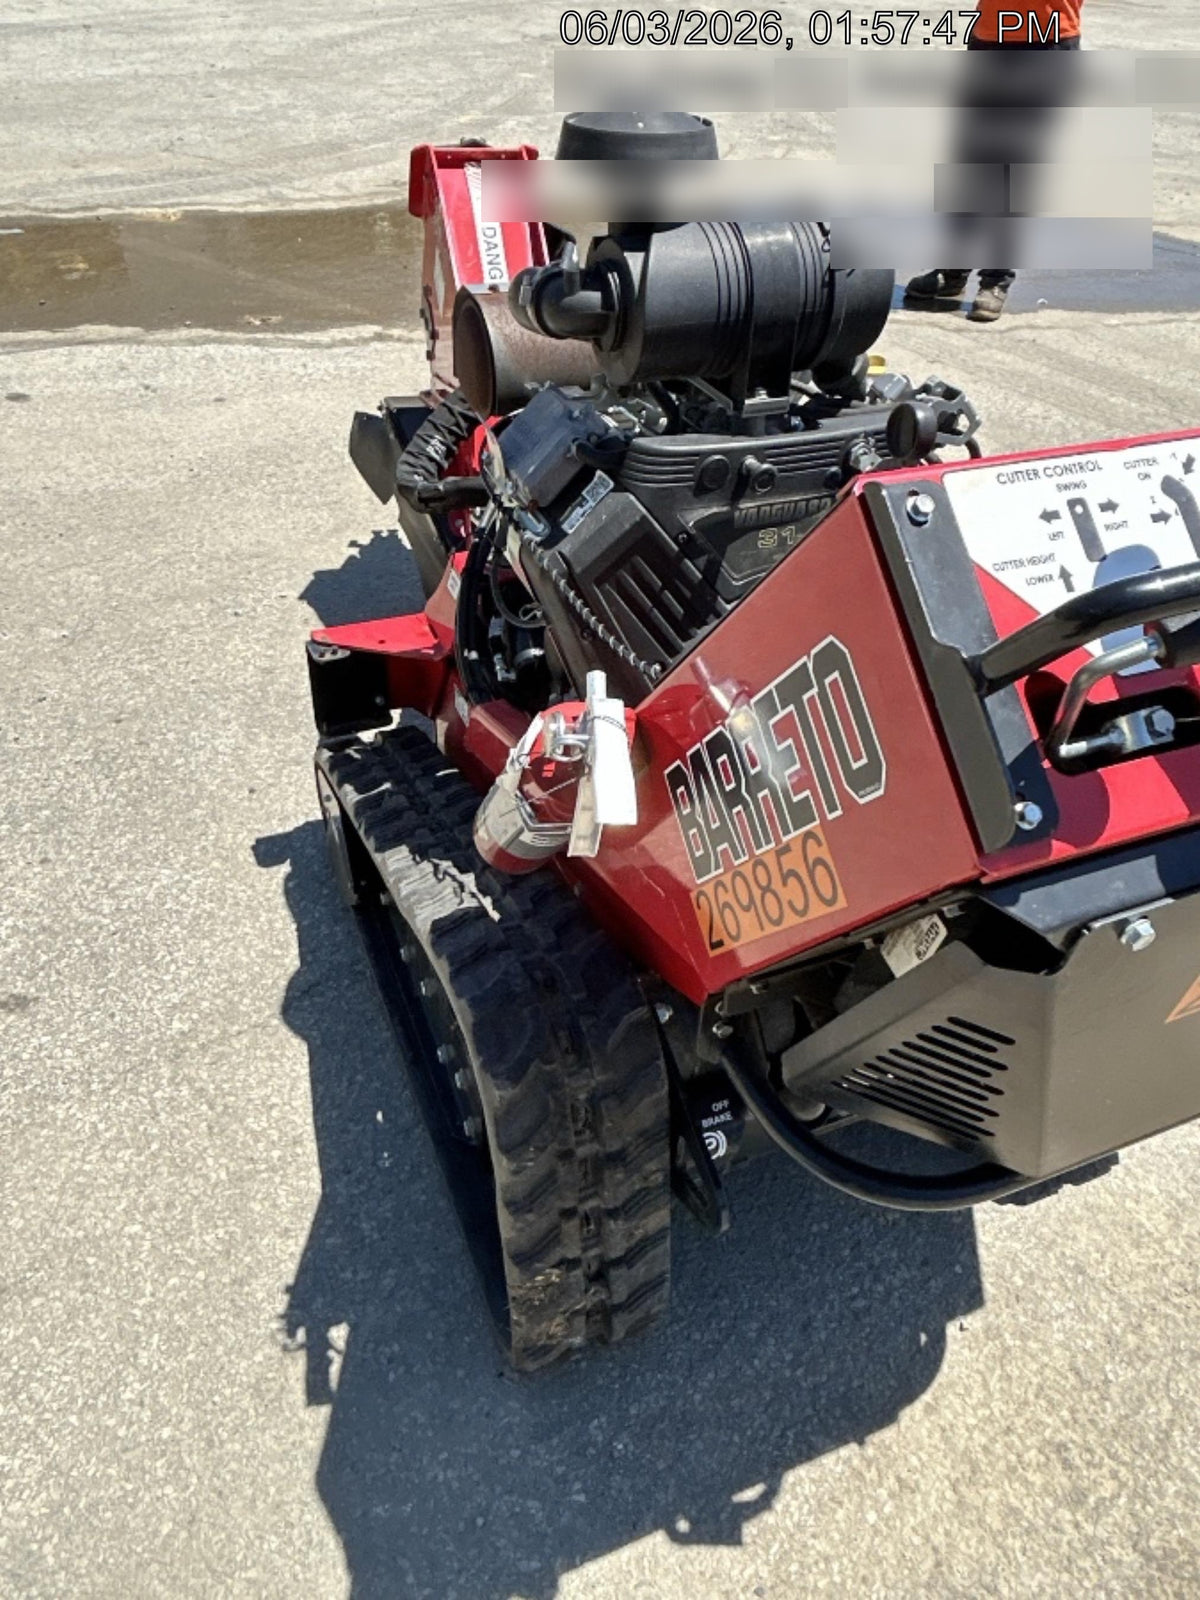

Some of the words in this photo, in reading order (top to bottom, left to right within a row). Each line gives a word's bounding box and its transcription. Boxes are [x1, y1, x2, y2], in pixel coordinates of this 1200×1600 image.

[1123, 457, 1160, 471] CUTTER
[995, 467, 1041, 485] CUTTER
[1042, 459, 1103, 479] CONTROL
[1137, 472, 1152, 482] ON
[1055, 480, 1088, 493] SWING
[1103, 519, 1129, 532] RIGHT
[1048, 531, 1064, 541] LEFT
[992, 556, 1026, 572] CUTTER
[1026, 552, 1057, 568] HEIGHT
[1025, 573, 1054, 586] LOWER
[663, 634, 887, 885] BARRETO
[695, 830, 839, 951] 269856
[711, 1099, 729, 1111] OFF
[701, 1111, 733, 1128] BRAKE
